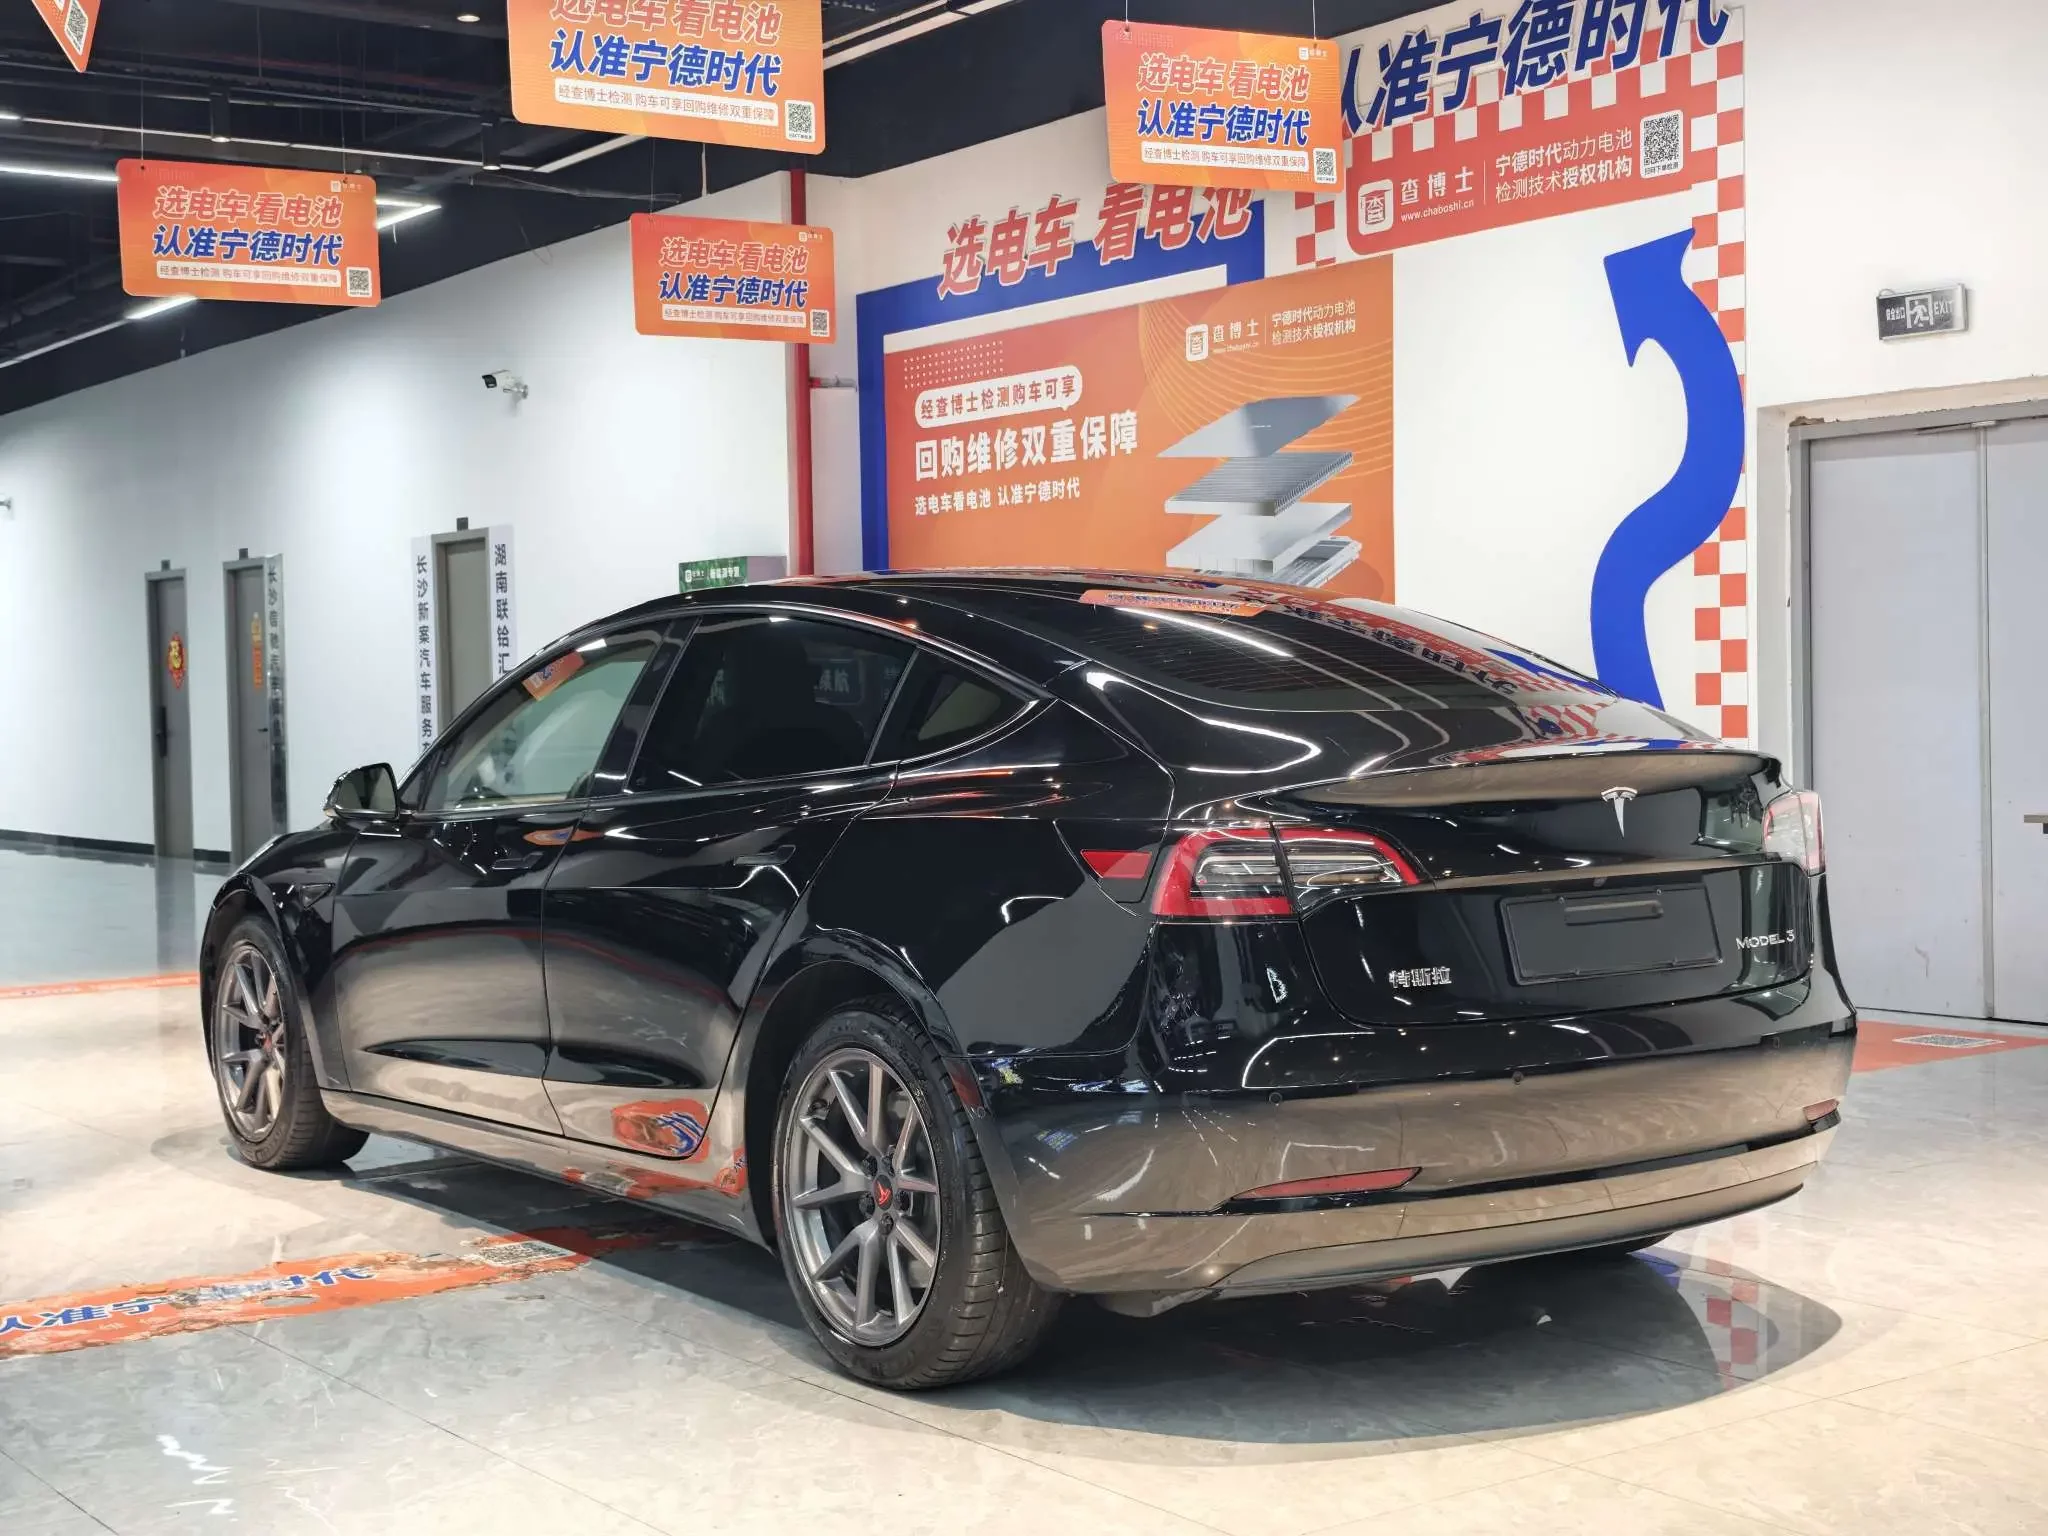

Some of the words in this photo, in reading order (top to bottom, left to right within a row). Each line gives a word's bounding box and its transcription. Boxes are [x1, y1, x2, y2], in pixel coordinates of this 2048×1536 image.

[671, 0, 783, 46] 看电池
[549, 27, 782, 97] 认准宁德时代
[1136, 52, 1225, 96] 选电车
[1228, 60, 1311, 102] 看电池
[1137, 98, 1310, 146] 认准宁德时代
[1495, 126, 1633, 176] 宁德时代动力电池
[1495, 155, 1633, 204] 检测技术授权机构
[153, 185, 249, 222] 选电车
[252, 191, 343, 229] 看电池
[1400, 199, 1475, 222] www.chaboshi.cn
[152, 224, 343, 266] 认准宁德时代
[660, 236, 737, 270] 选电车
[738, 241, 809, 274] 看电池
[936, 194, 1079, 301] 选电车
[1093, 182, 1254, 266] 看电池
[659, 272, 808, 309] 认准宁德时代
[1933, 300, 1955, 316] EXIT
[1271, 299, 1356, 328] 宁德时代动力电池
[1271, 319, 1356, 346] 检测技术授权机构
[920, 374, 1076, 420] 经查博士检测购车可享
[915, 409, 1139, 482] 回购维修双重保障
[914, 486, 992, 516] 选电车看电池
[997, 476, 1081, 506] 认准宁德时代
[1735, 933, 1786, 950] MODEL
[1786, 928, 1796, 942] 3
[1388, 966, 1452, 989] 特斯拉
